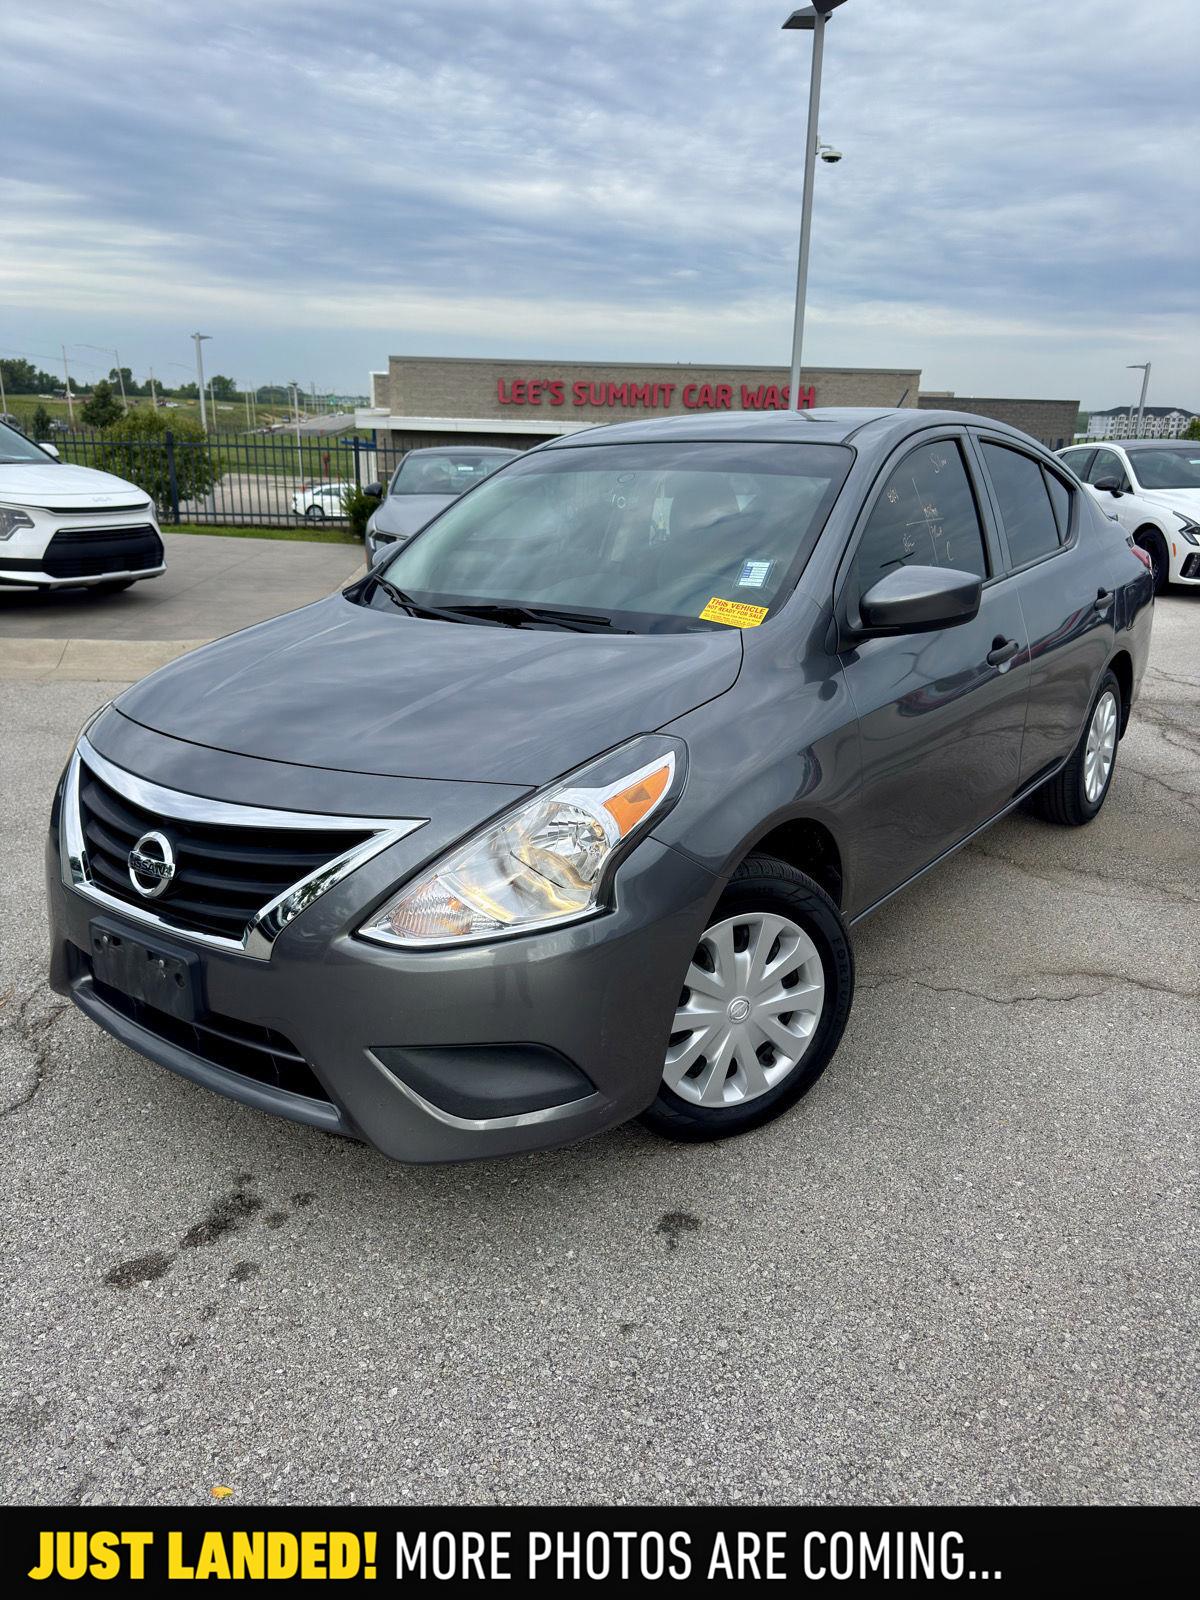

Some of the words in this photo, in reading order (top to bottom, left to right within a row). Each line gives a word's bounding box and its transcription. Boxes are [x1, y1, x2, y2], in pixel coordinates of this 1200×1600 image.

[497, 378, 565, 406] LEE'S
[572, 380, 676, 408] SUMMIT
[683, 383, 732, 409] CAR
[741, 384, 816, 410] WASH
[711, 599, 728, 607] THIS
[731, 603, 766, 615] VEHICLE
[748, 612, 764, 620] SALE
[130, 852, 173, 879] SSAN
